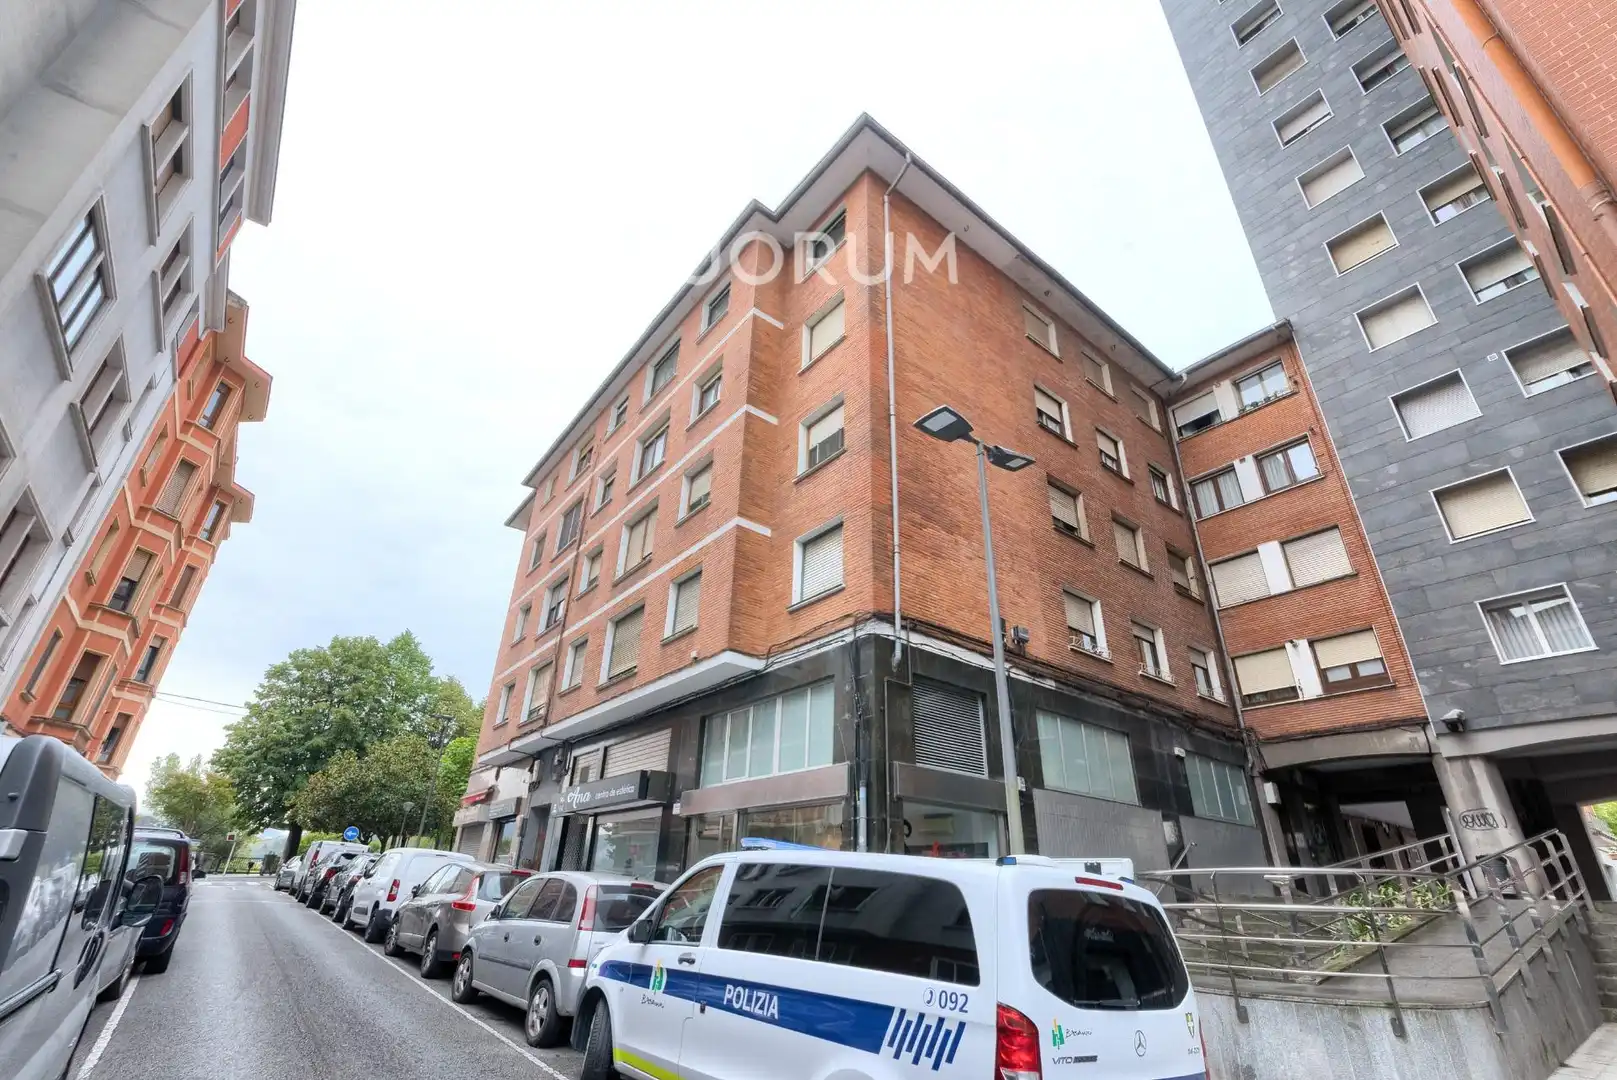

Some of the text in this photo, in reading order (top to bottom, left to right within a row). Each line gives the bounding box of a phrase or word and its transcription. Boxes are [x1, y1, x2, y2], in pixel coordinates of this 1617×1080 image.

[567, 786, 592, 808] Ana
[723, 984, 780, 1020] POLIZIA
[938, 990, 969, 1014] 092
[1052, 1056, 1073, 1065] VITO
